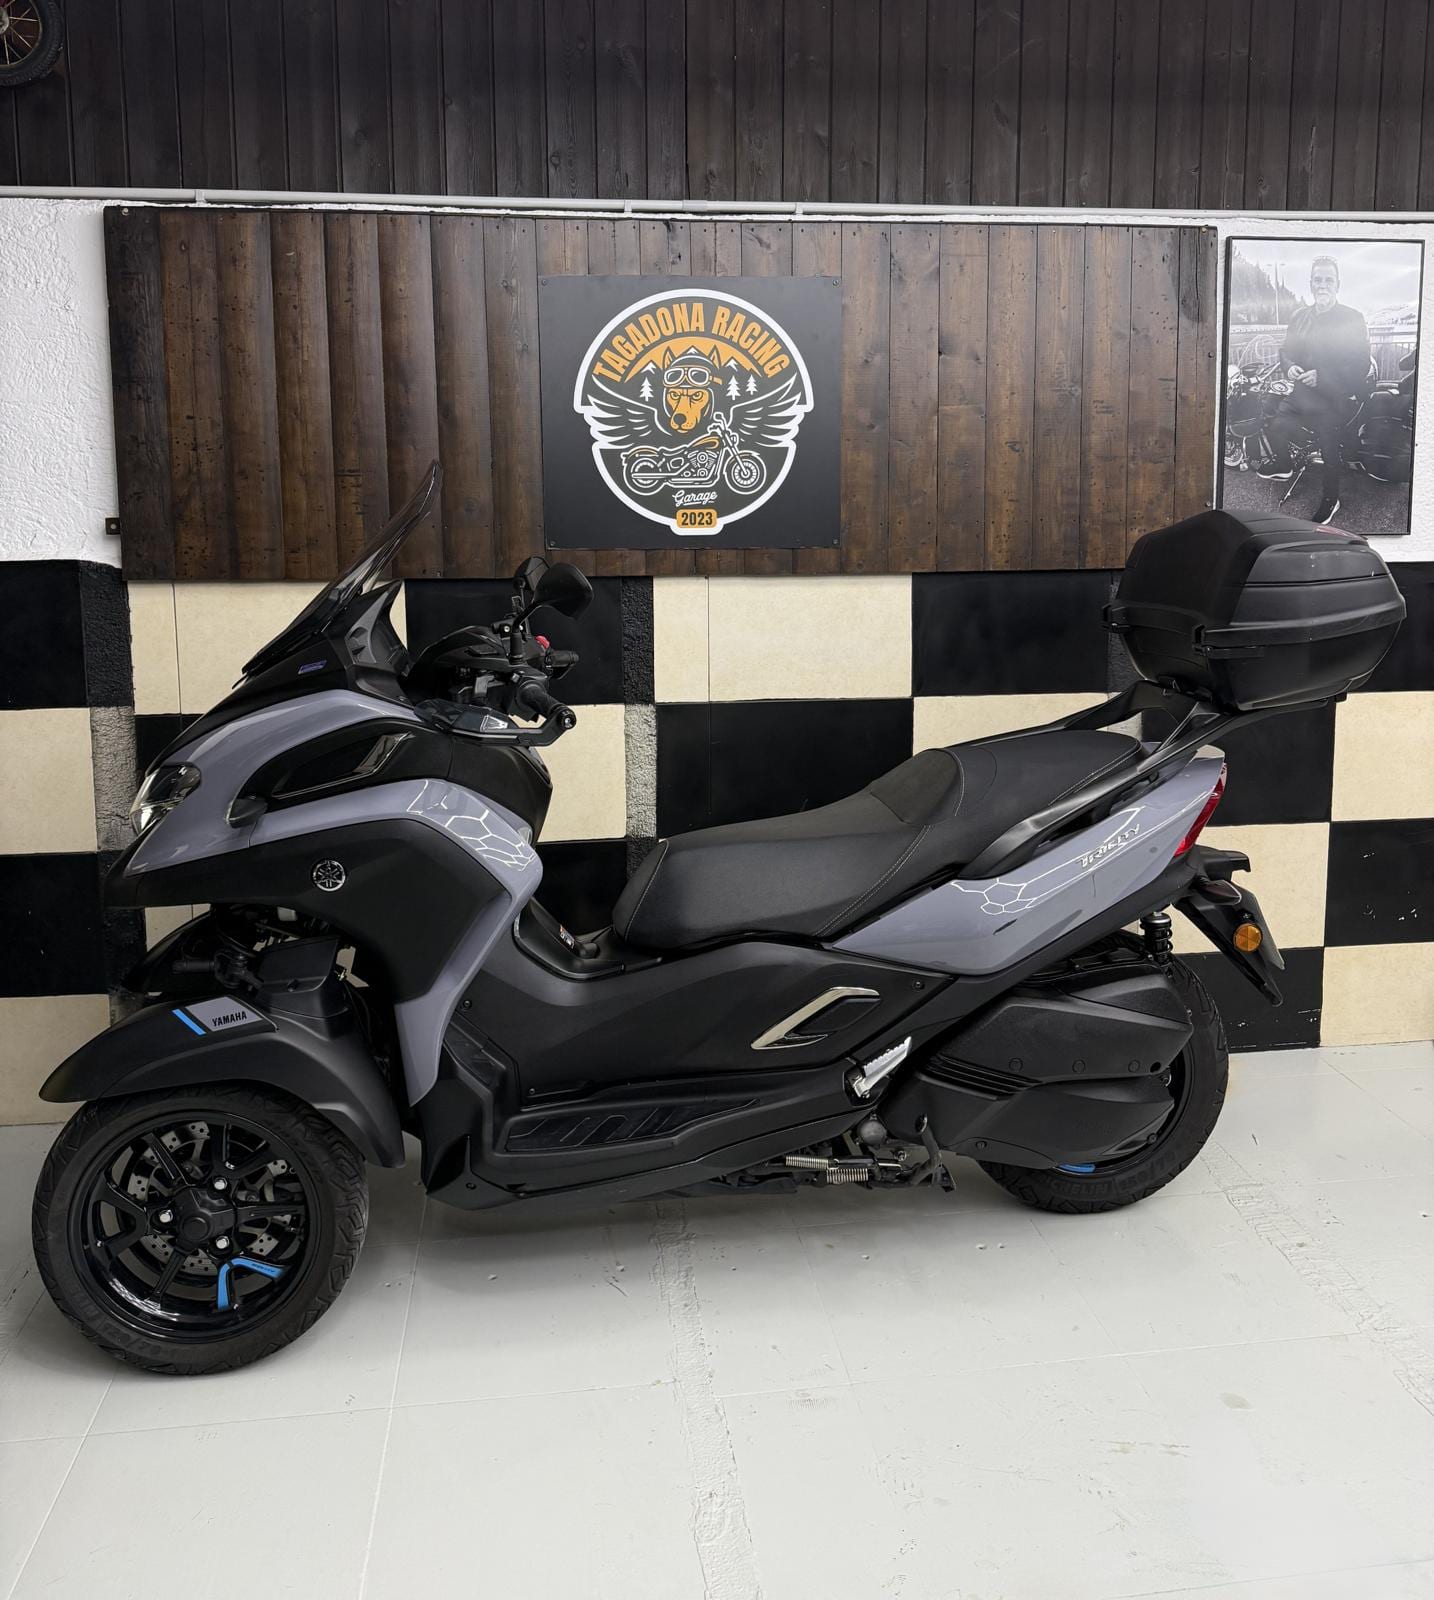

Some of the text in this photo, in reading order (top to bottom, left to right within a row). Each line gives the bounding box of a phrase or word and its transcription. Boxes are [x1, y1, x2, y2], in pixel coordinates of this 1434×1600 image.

[592, 303, 791, 383] TAGADONA RACING
[672, 490, 718, 507] Garage
[681, 511, 713, 526] 2023
[212, 1011, 247, 1027] YAMAHA
